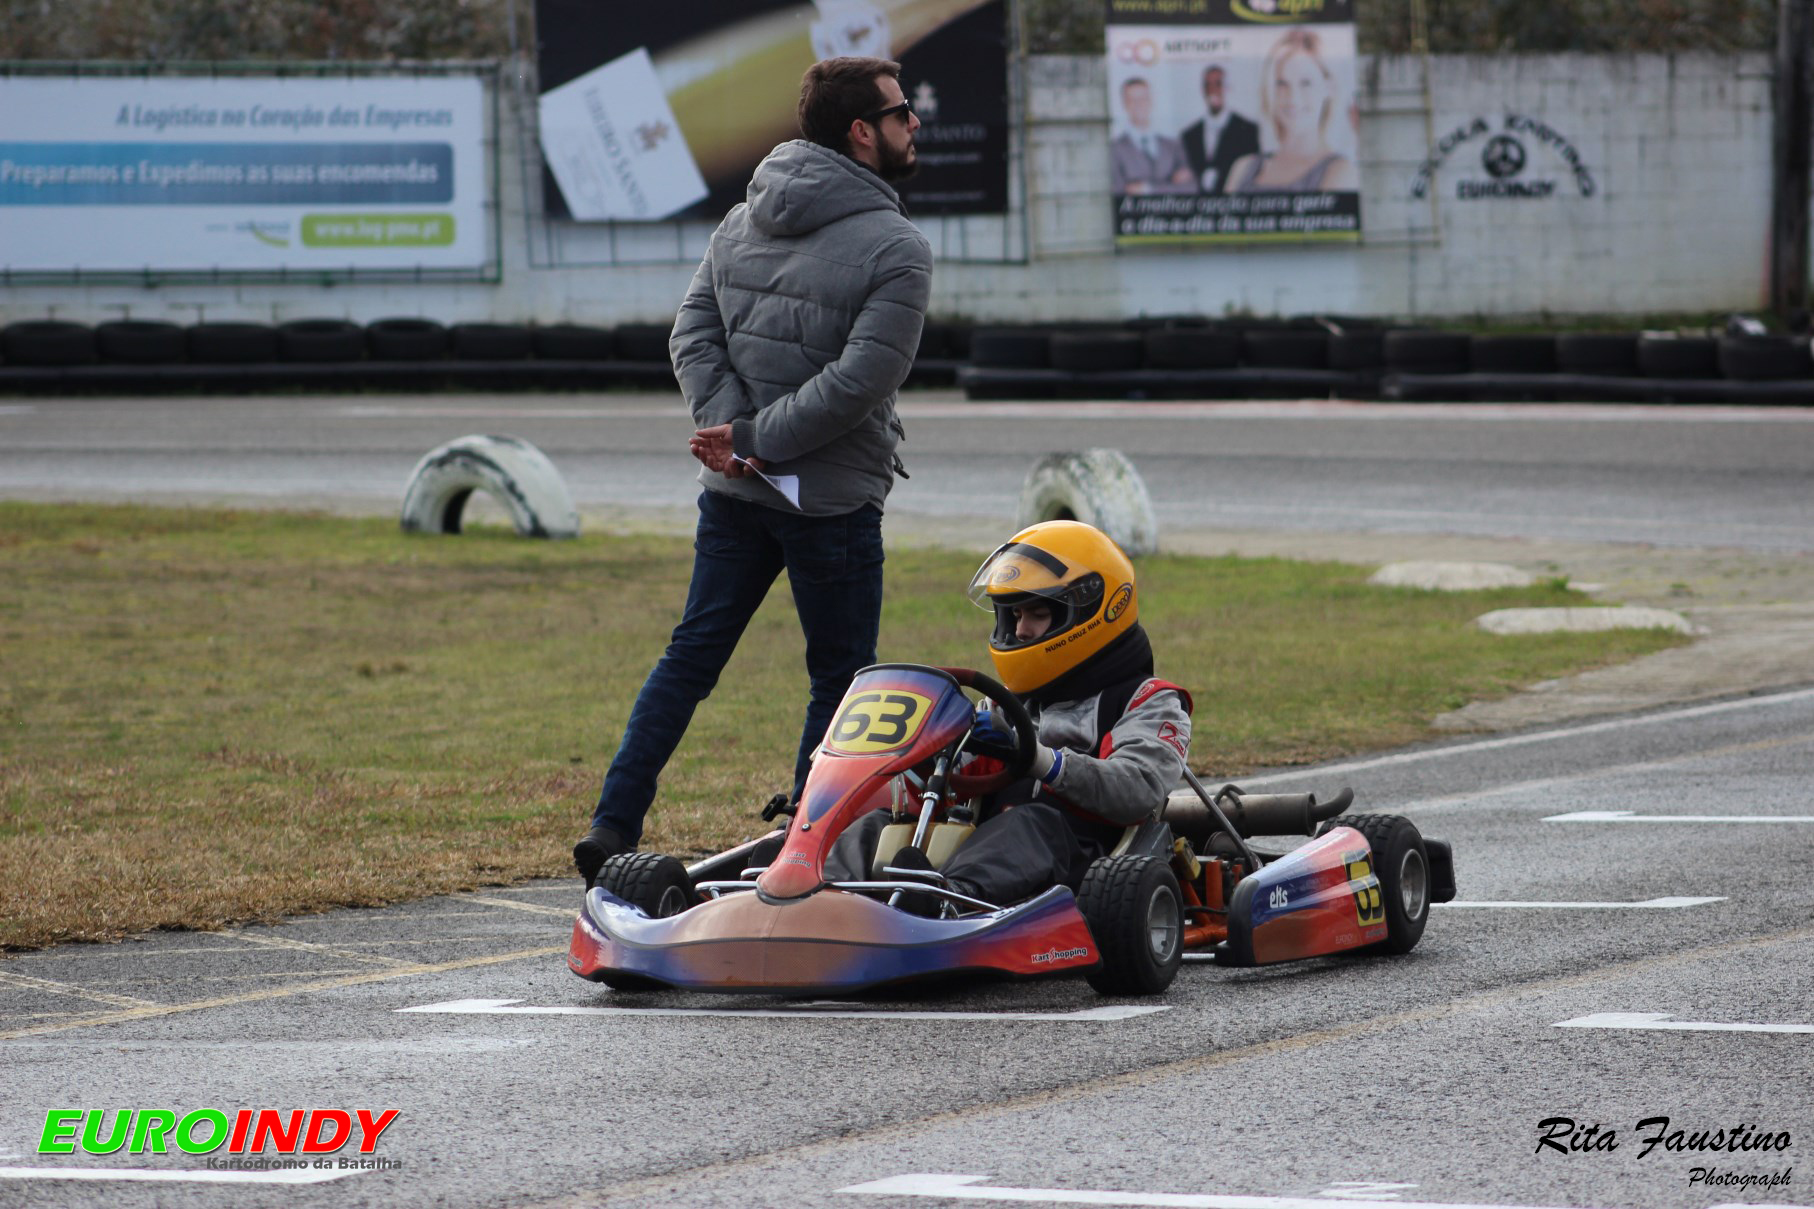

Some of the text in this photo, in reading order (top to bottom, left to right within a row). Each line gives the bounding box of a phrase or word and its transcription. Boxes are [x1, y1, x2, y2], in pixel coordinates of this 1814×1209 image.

[116, 103, 131, 126] A
[220, 110, 247, 126] no
[328, 103, 360, 126] das
[365, 103, 453, 132] Empresas
[1, 159, 439, 189] Preparamos e Expedimos as suas encomendas
[1137, 194, 1194, 213] melhor
[1244, 218, 1278, 232] sua
[1279, 215, 1357, 234] empresa
[1045, 639, 1067, 653] NUNO
[1068, 627, 1087, 643] CRUZ
[832, 694, 918, 745] 63
